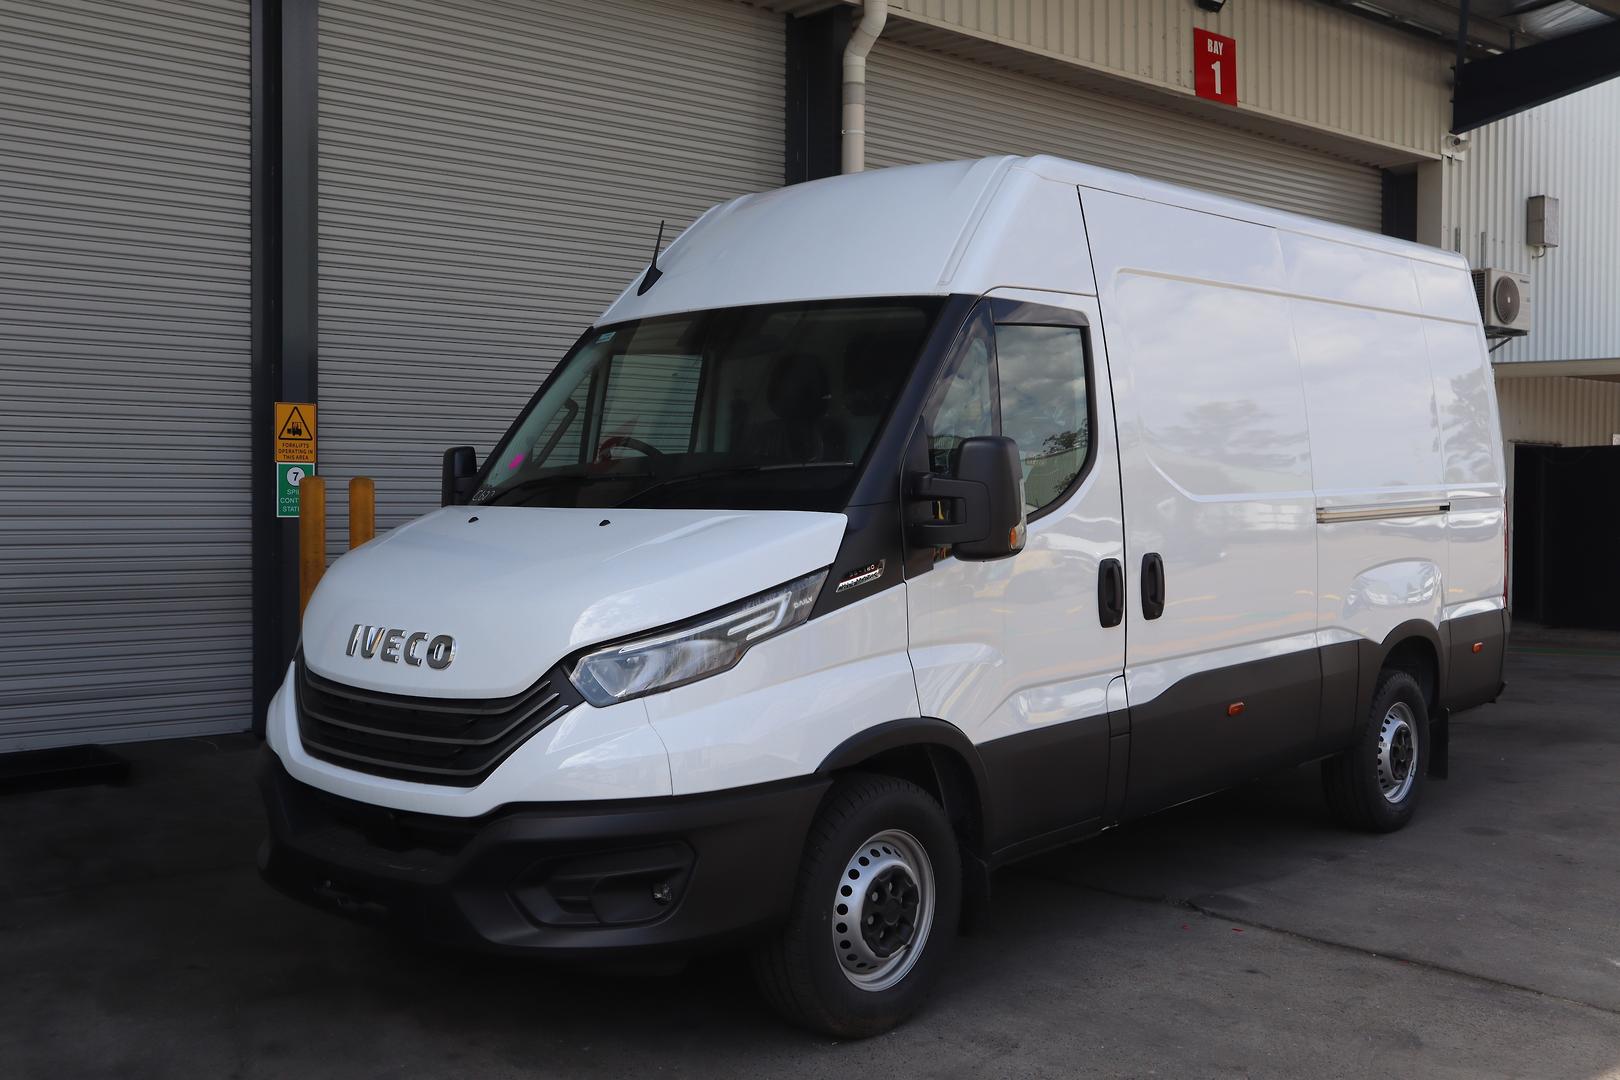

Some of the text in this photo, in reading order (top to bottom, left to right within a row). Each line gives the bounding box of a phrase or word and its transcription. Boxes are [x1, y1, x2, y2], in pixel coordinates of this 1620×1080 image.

[1207, 38, 1223, 56] BAY
[1211, 60, 1222, 95] 1
[292, 471, 299, 481] 7
[345, 624, 457, 671] IVECO
